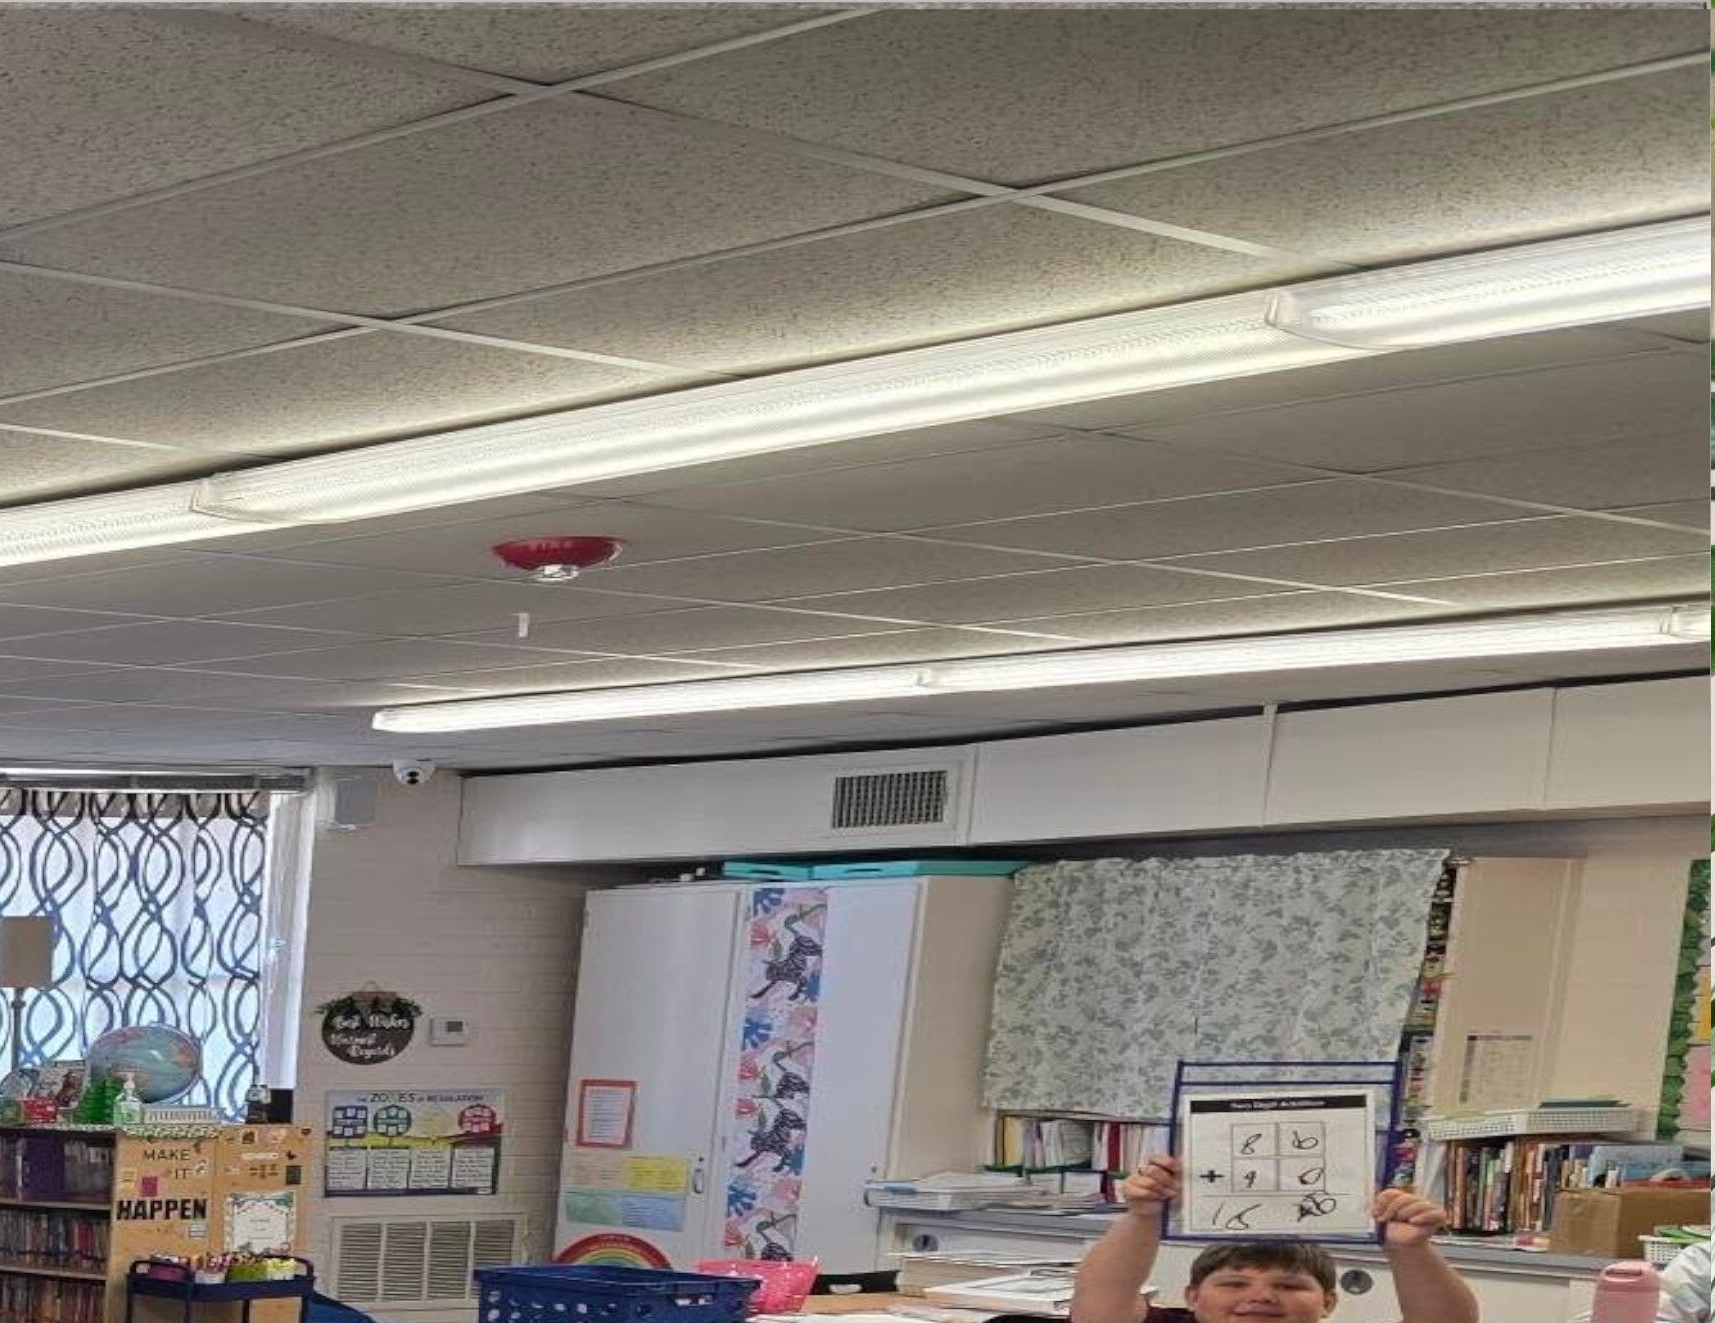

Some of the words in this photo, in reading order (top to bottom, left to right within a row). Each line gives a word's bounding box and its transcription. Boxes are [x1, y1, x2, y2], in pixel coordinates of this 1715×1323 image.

[370, 1092, 415, 1103] ZOES
[1241, 1133, 1262, 1155] 8
[144, 1150, 191, 1161] MAKE
[175, 1168, 188, 1180] IT
[116, 1199, 207, 1220] HAPPEN
